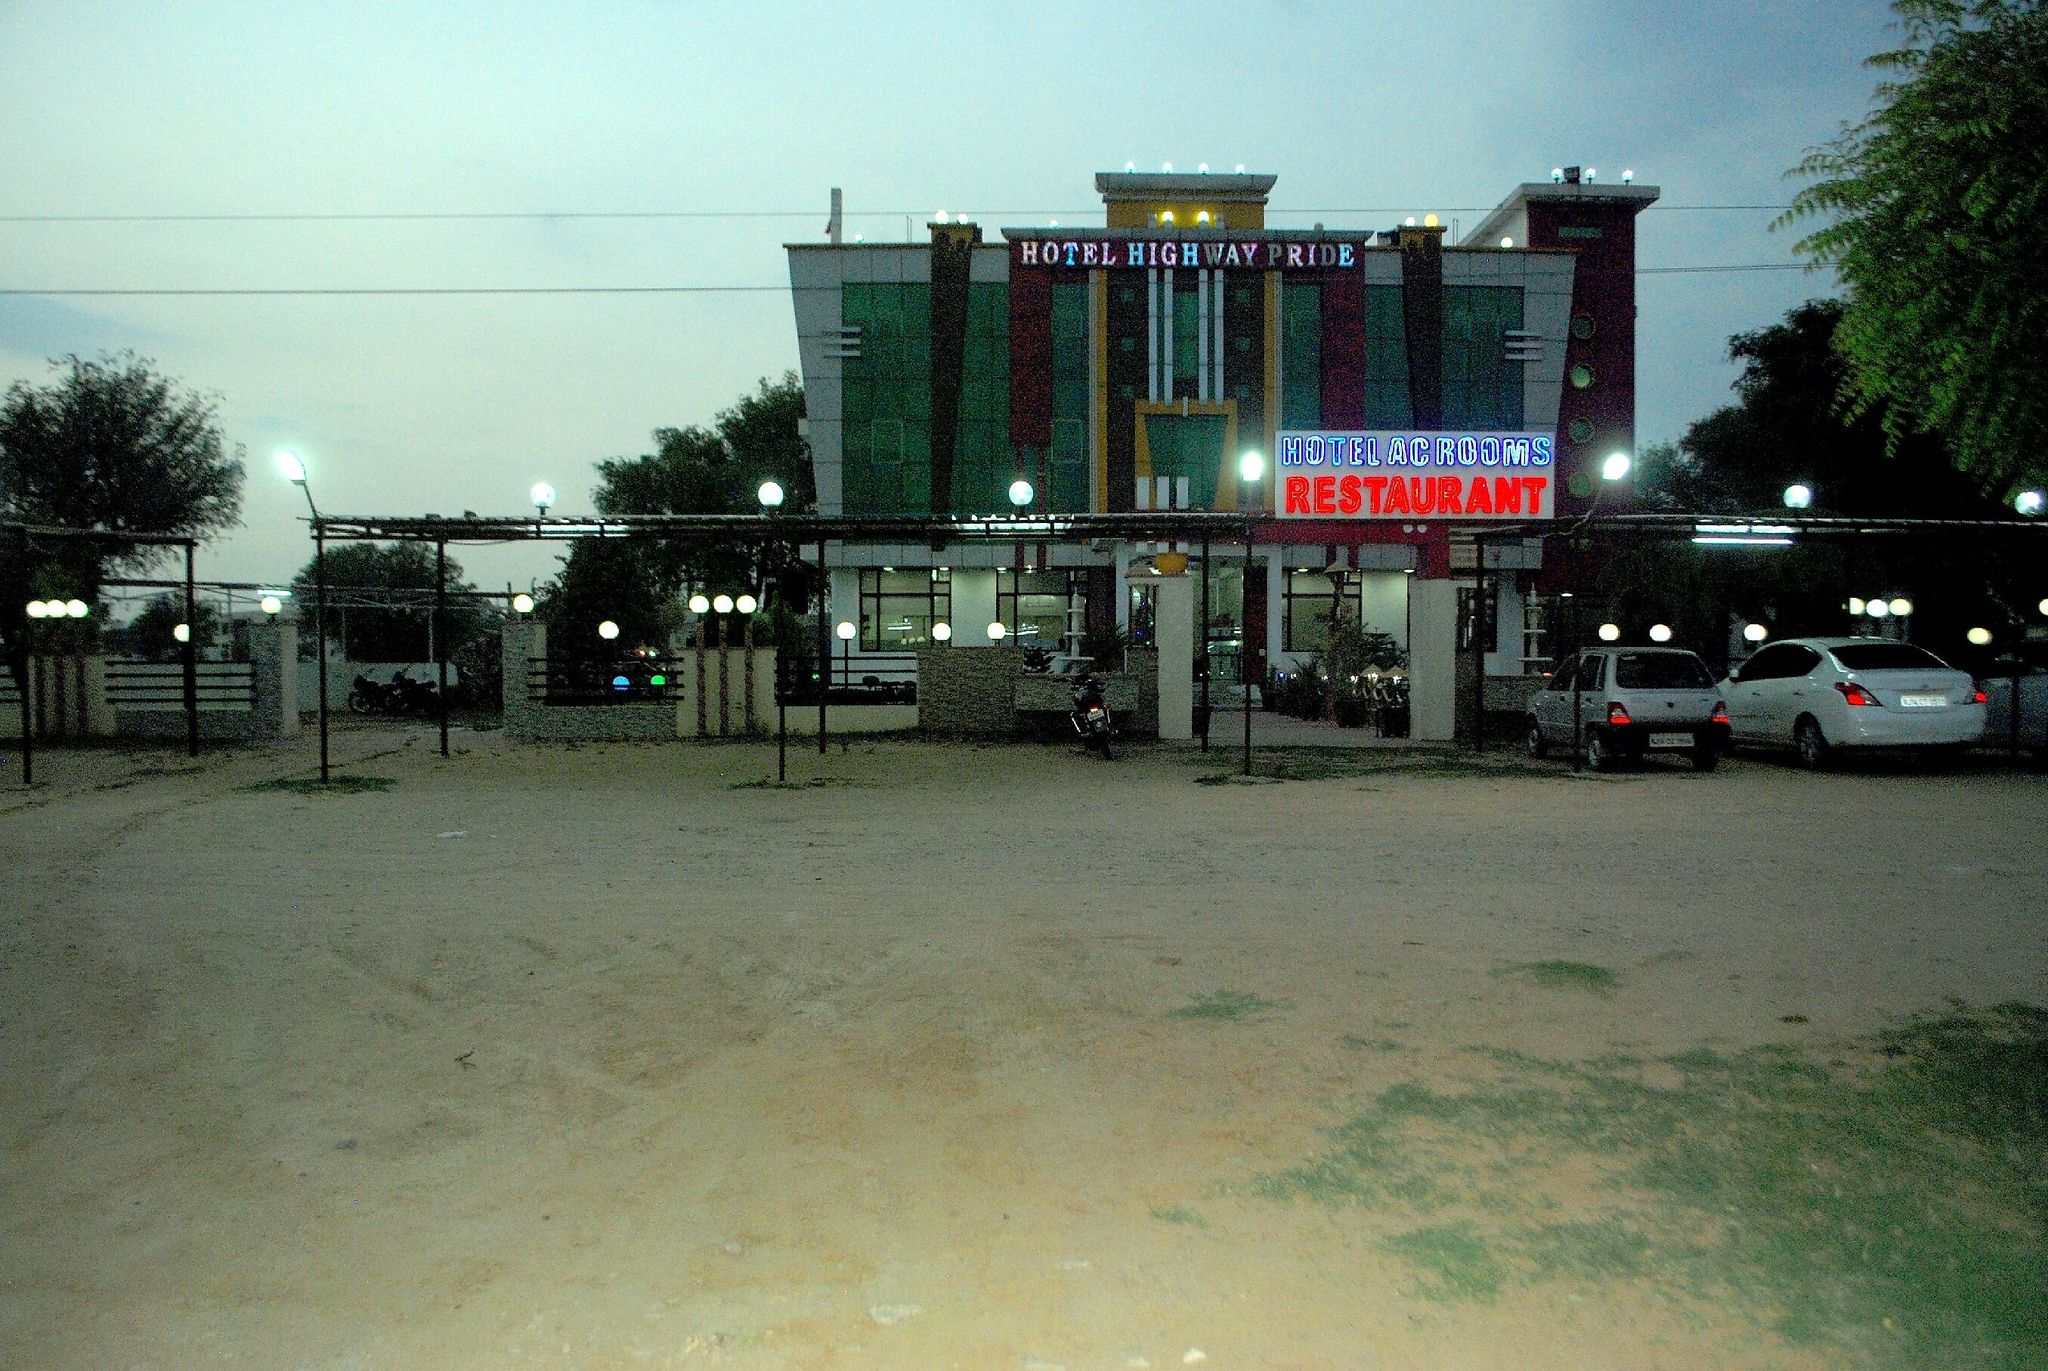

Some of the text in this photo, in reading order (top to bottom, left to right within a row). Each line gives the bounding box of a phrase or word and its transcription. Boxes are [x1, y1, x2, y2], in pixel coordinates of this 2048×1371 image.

[1022, 241, 1355, 268] HOTEL HIGHWAY PRIDE
[1281, 435, 1552, 467] HOTEL AC ROOMS
[1285, 475, 1547, 515] RESTAURANT
